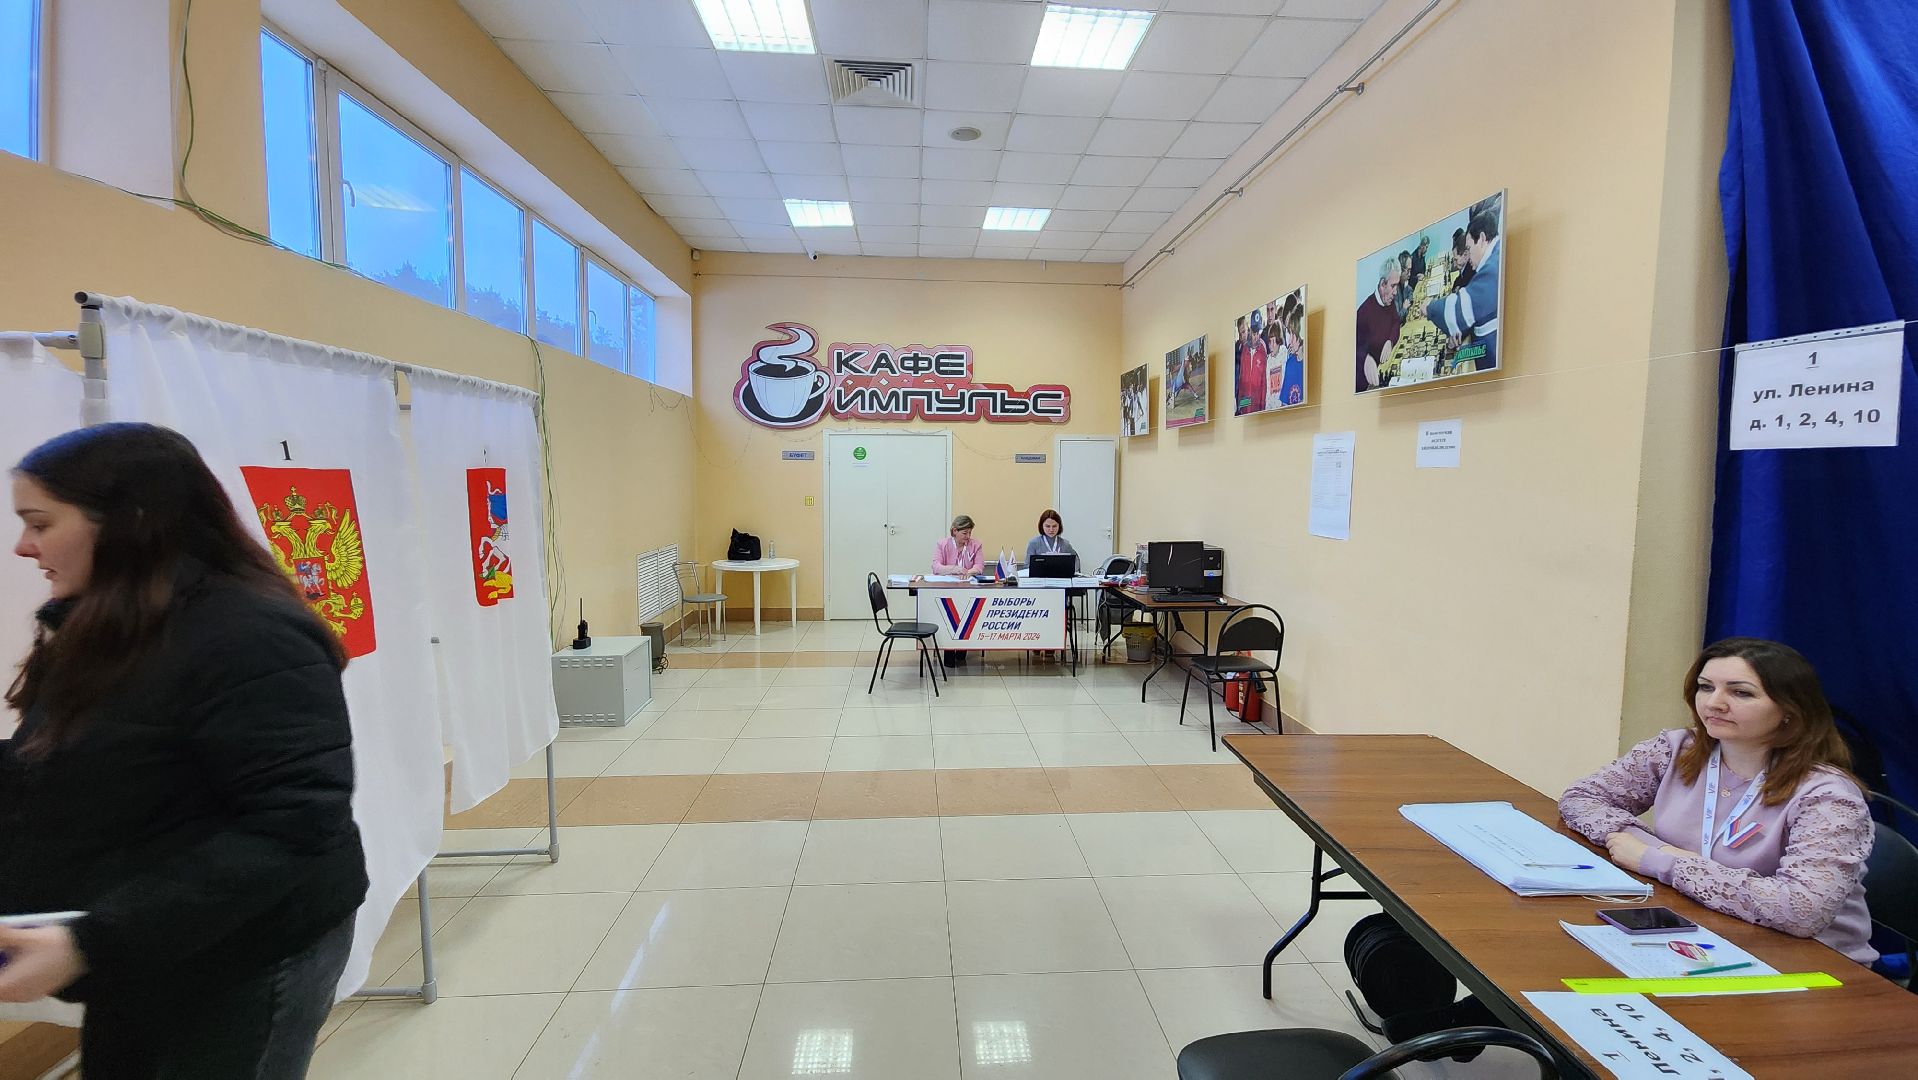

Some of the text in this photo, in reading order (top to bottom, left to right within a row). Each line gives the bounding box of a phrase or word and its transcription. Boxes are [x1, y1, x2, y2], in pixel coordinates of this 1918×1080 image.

[835, 350, 967, 377] КАФЕ
[1807, 351, 1818, 365] 1
[835, 388, 1065, 416] ИМПУЛЬС
[1752, 380, 1875, 403] ул. Ленина
[1749, 408, 1881, 431] д. 1, 2, 4, 10
[279, 439, 293, 461] 1
[992, 597, 1037, 607] ВЫБОРЫ
[986, 609, 1050, 620] ПРЕЗИДЕНТА
[981, 621, 1022, 631] РОССИИ
[998, 632, 1022, 641] МАРТА
[1023, 632, 1041, 641] 2024
[1615, 1002, 1646, 1022] 10
[1590, 1007, 1682, 1076] Ленина
